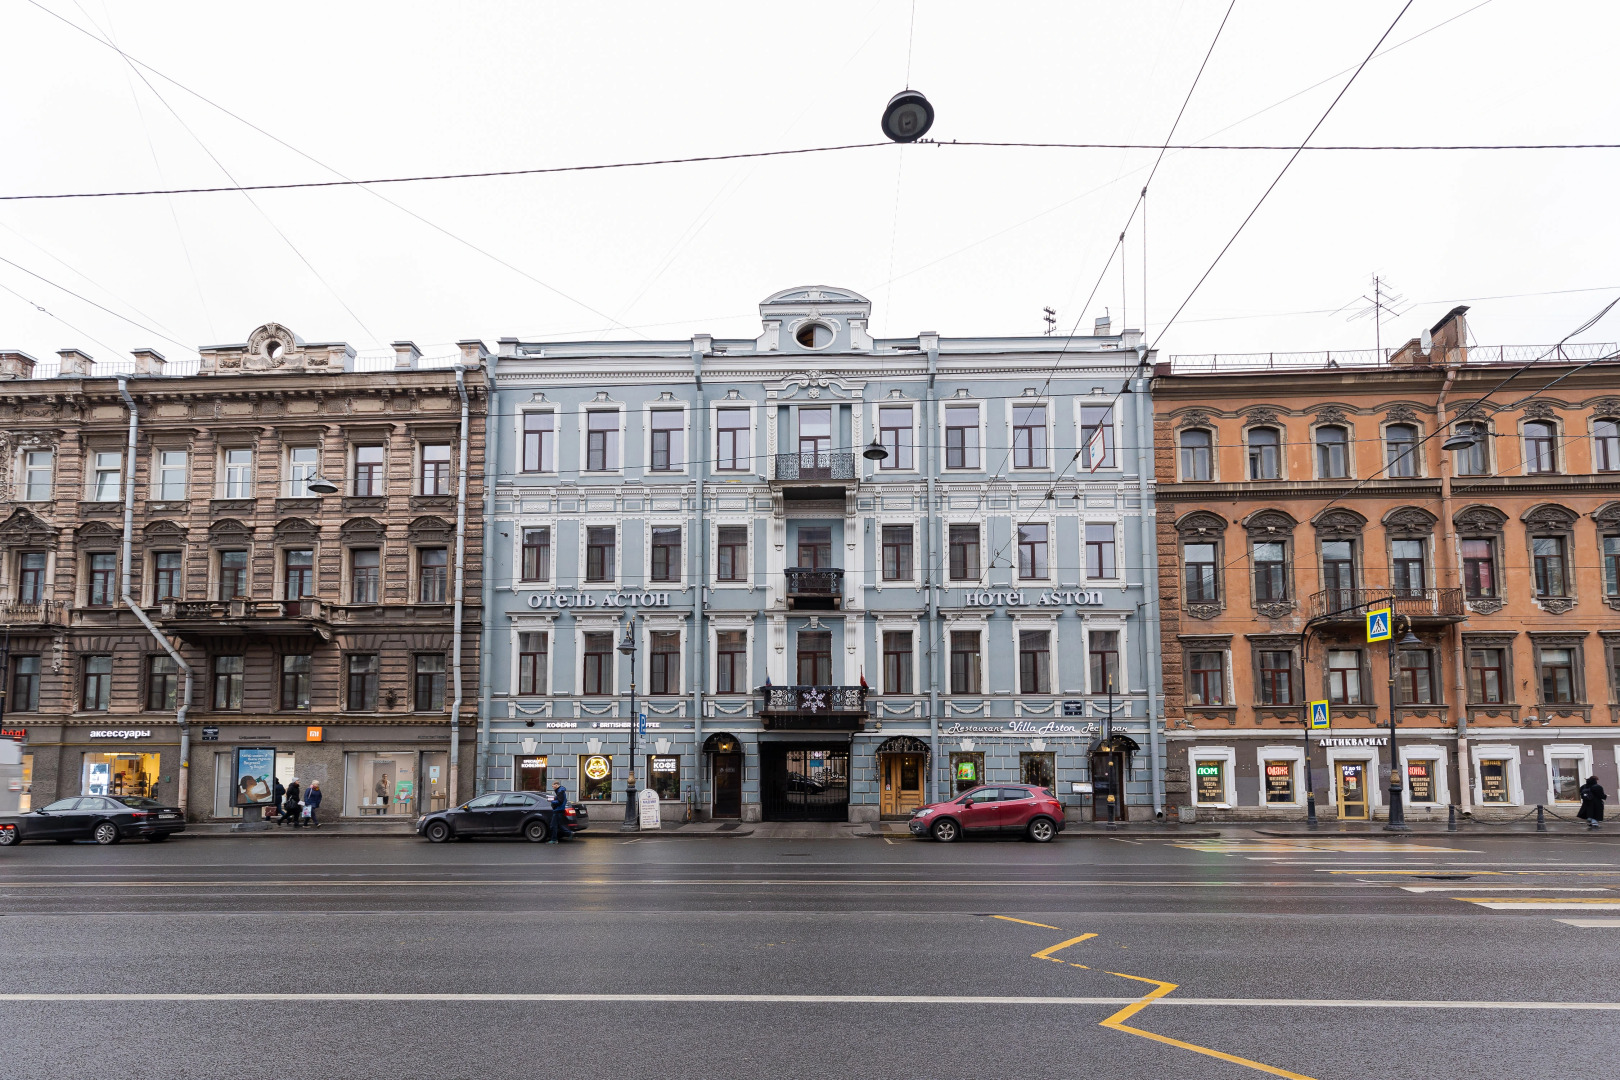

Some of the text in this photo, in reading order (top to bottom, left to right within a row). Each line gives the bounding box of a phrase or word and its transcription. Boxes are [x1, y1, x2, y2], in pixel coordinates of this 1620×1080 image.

[948, 721, 1076, 735] Restaurant Villa Aston
[90, 729, 151, 739] аксессуары
[1319, 737, 1389, 746] АНТИКВАРИАТ
